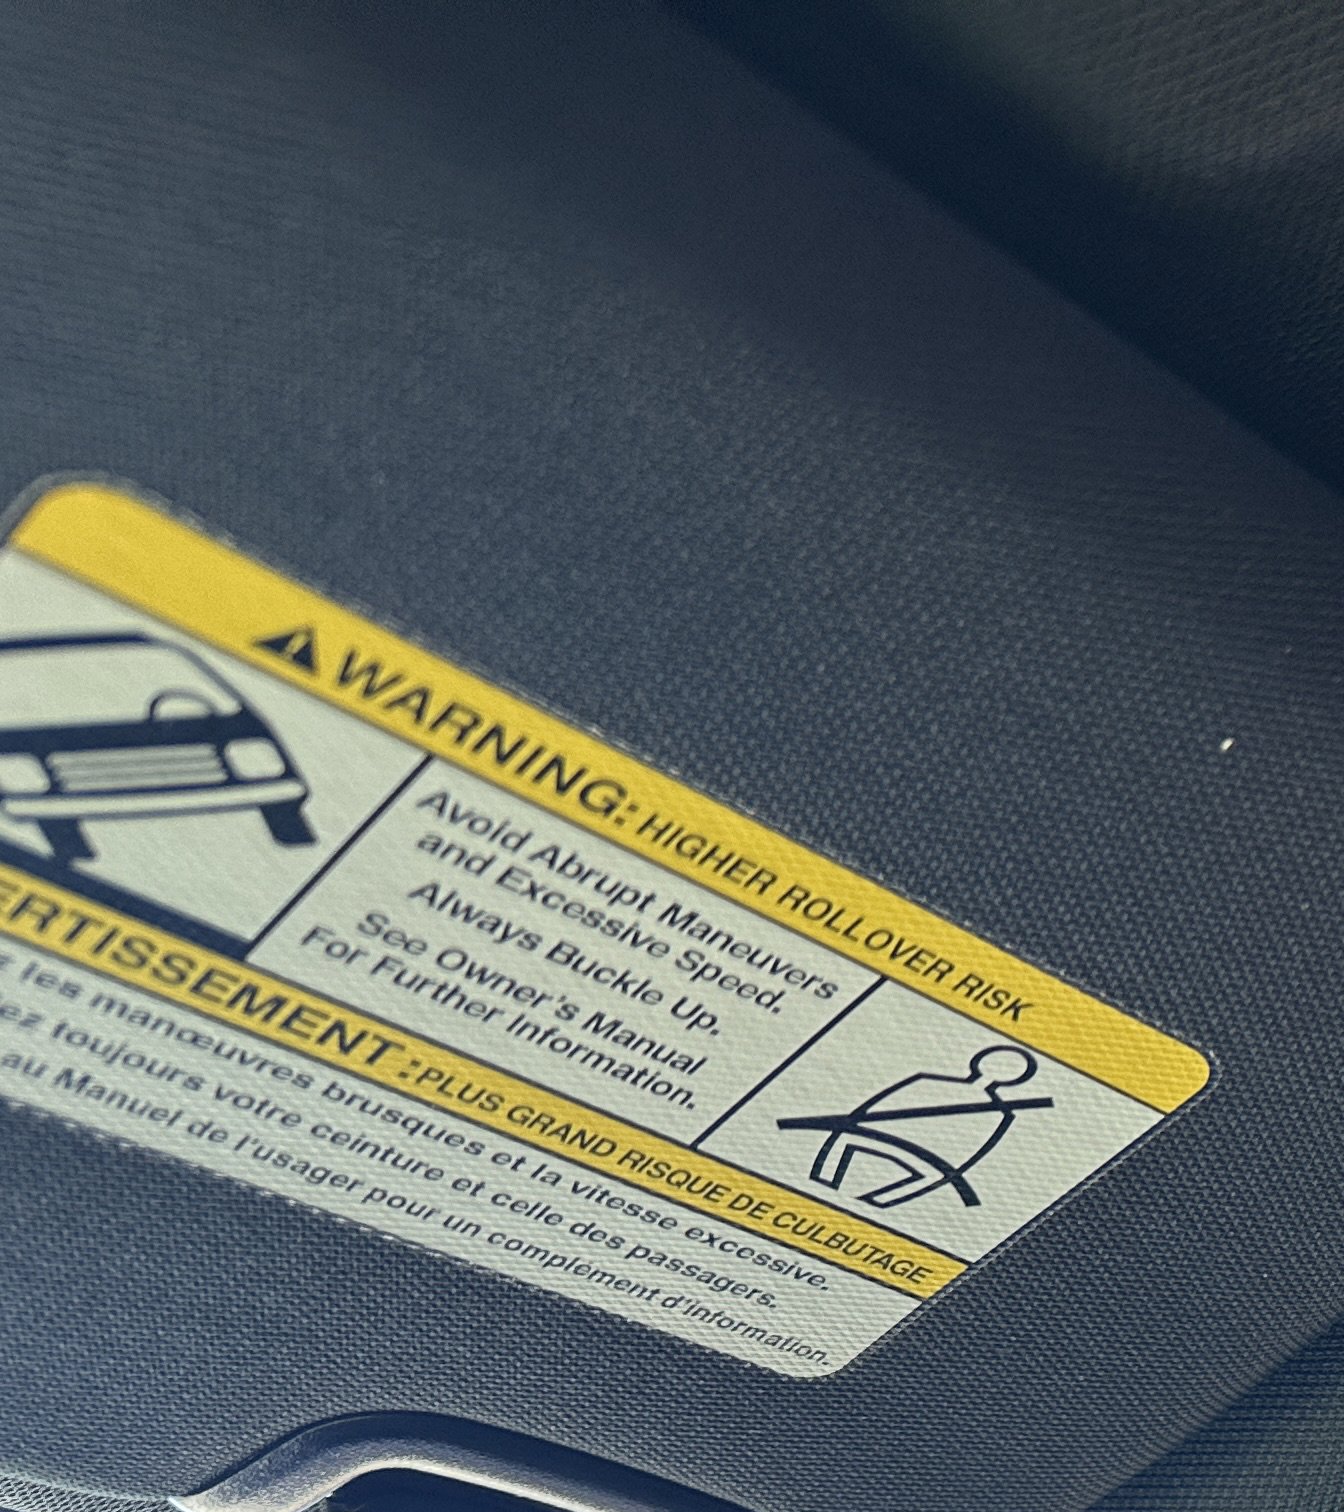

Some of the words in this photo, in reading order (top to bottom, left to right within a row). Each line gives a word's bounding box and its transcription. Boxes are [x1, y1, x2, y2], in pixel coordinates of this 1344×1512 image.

[336, 650, 640, 826] WARNING:
[636, 813, 779, 896] HIGHER
[777, 884, 956, 983] ROLLOVER
[955, 973, 1034, 1022] RISK
[415, 790, 533, 854] Avoid
[525, 843, 656, 913] Abrupt
[657, 902, 839, 1000] Maneuvers
[416, 832, 497, 877] and
[495, 866, 671, 959] Excessive
[674, 950, 789, 1014] Speed.
[298, 925, 370, 967] For
[369, 954, 505, 1024] Further
[505, 1013, 698, 1110] Information.
[357, 912, 428, 956] See
[435, 948, 582, 1023] Owner's
[581, 1011, 709, 1077] Manual
[407, 881, 542, 951] Always
[544, 940, 664, 1006] Buckle
[671, 996, 721, 1037] Up.
[2, 1053, 47, 1078] au
[53, 1067, 183, 1128] Manuel
[187, 1122, 229, 1143] de
[234, 1135, 366, 1193] l'usager
[362, 1186, 441, 1222] pour
[442, 1215, 482, 1236] un
[22, 961, 81, 999] les
[322, 1082, 485, 1155] brusques
[492, 1151, 526, 1172] et
[531, 1164, 562, 1186] la
[571, 1176, 678, 1231] vitesse
[684, 1225, 830, 1291] excessive.
[50, 1022, 205, 1091] toujours
[213, 1085, 302, 1129] votre
[310, 1124, 445, 1182] ceinture
[452, 1171, 486, 1197] et
[490, 1191, 565, 1225] celle
[570, 1216, 624, 1250] des
[628, 1242, 777, 1310] passagers.
[416, 1066, 506, 1112] PLUS
[507, 1101, 617, 1158] GRAND
[617, 1150, 727, 1205] RISQUE
[727, 1192, 777, 1221] DE
[772, 1213, 933, 1284] CULBUTAGE
